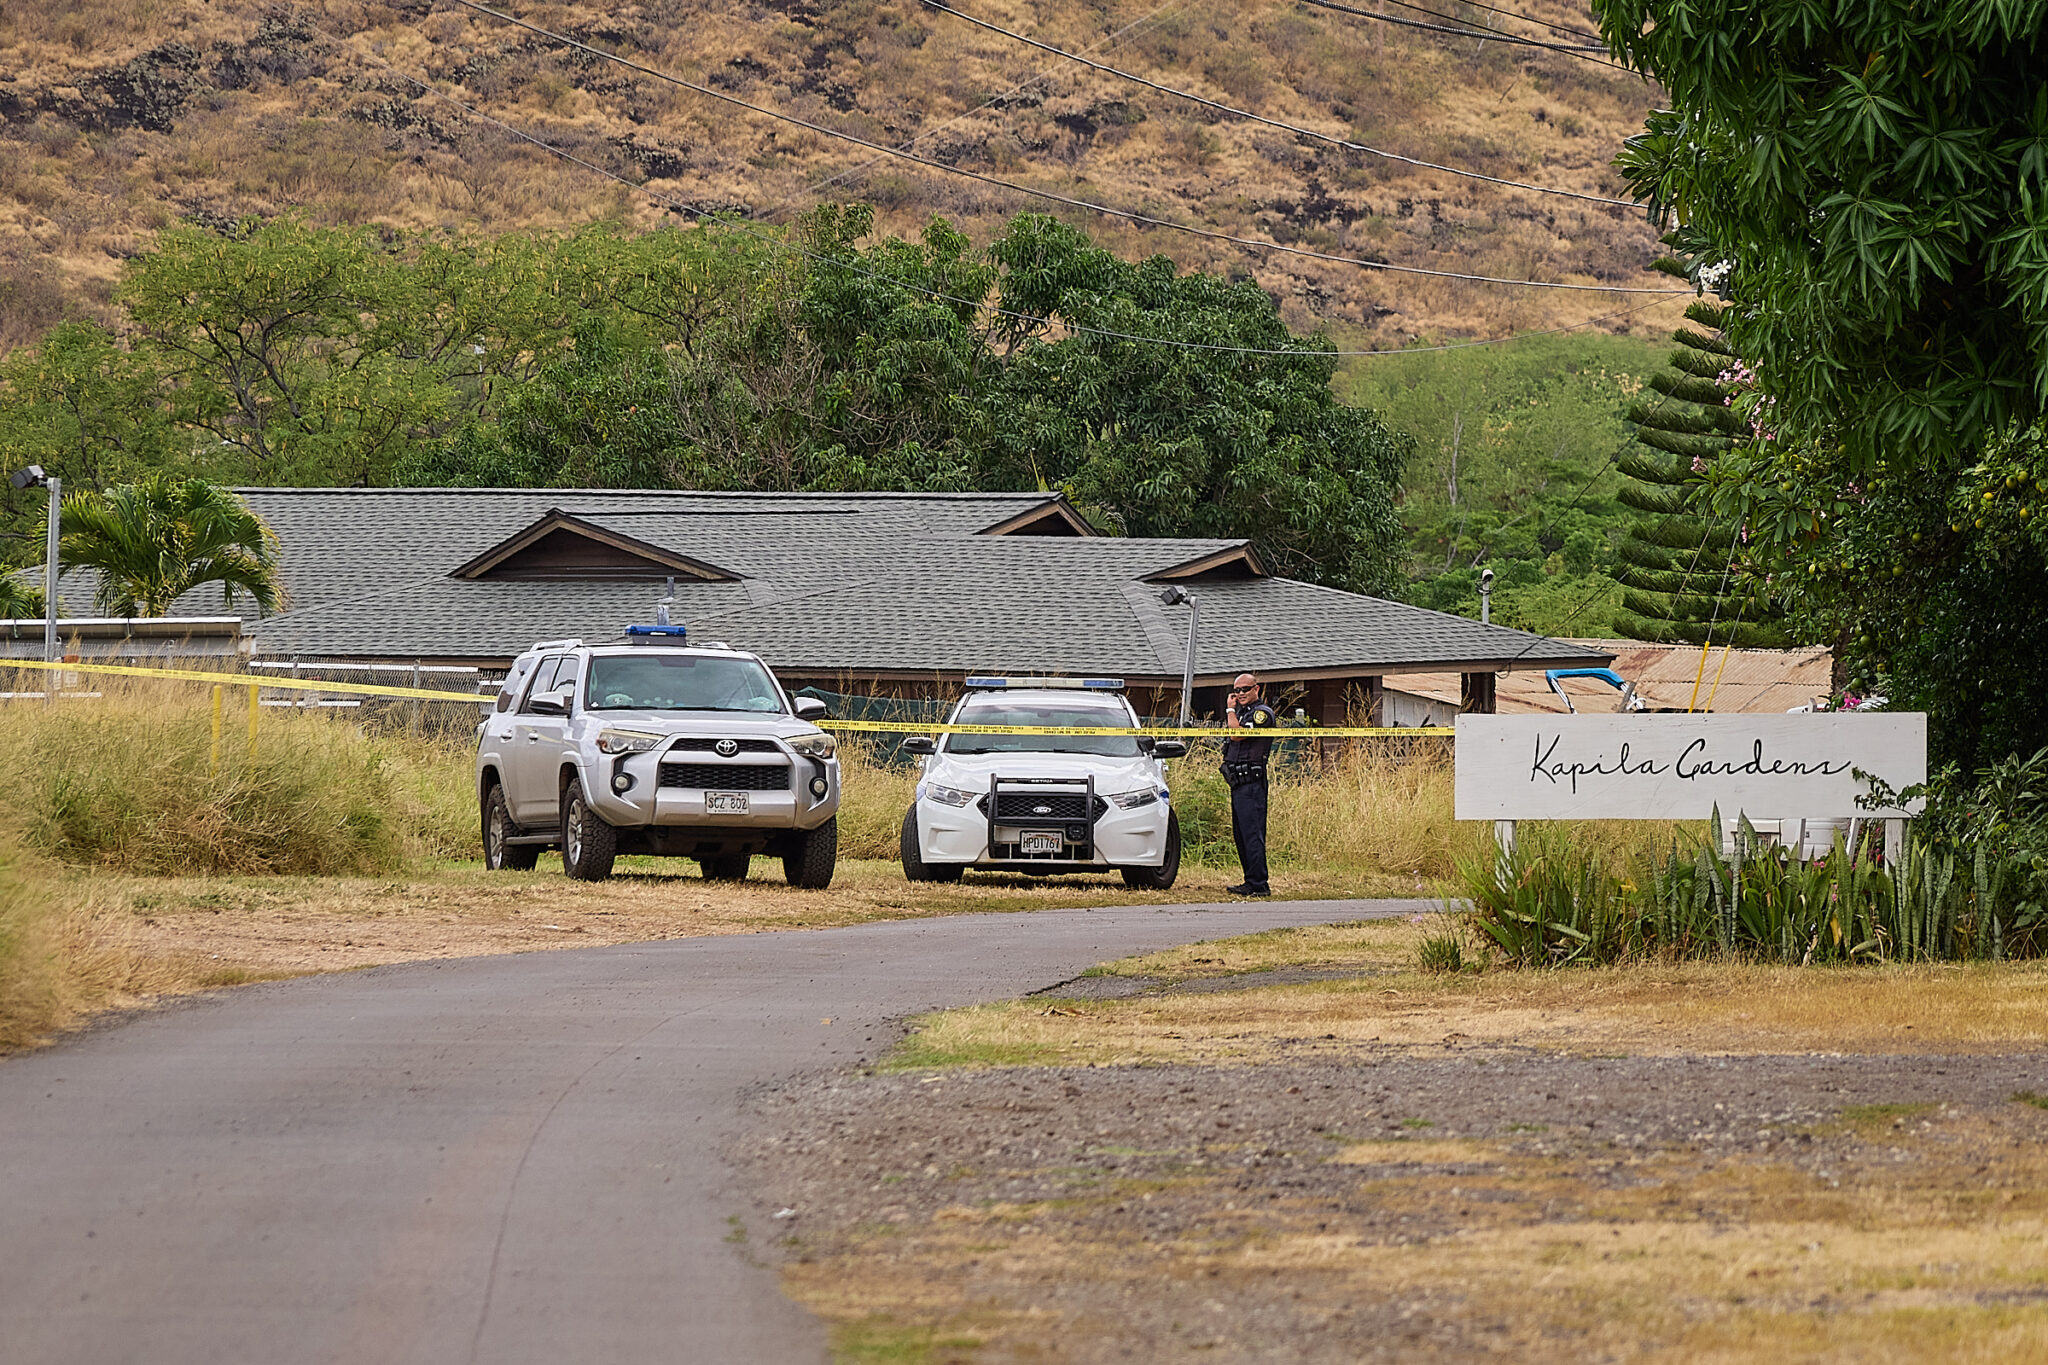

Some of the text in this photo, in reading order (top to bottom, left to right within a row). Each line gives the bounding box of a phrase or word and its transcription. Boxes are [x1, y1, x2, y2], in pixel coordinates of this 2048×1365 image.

[1530, 733, 1852, 794] Kapila Gardens
[708, 797, 747, 810] SCZ 802
[1023, 837, 1060, 849] HPD1767
